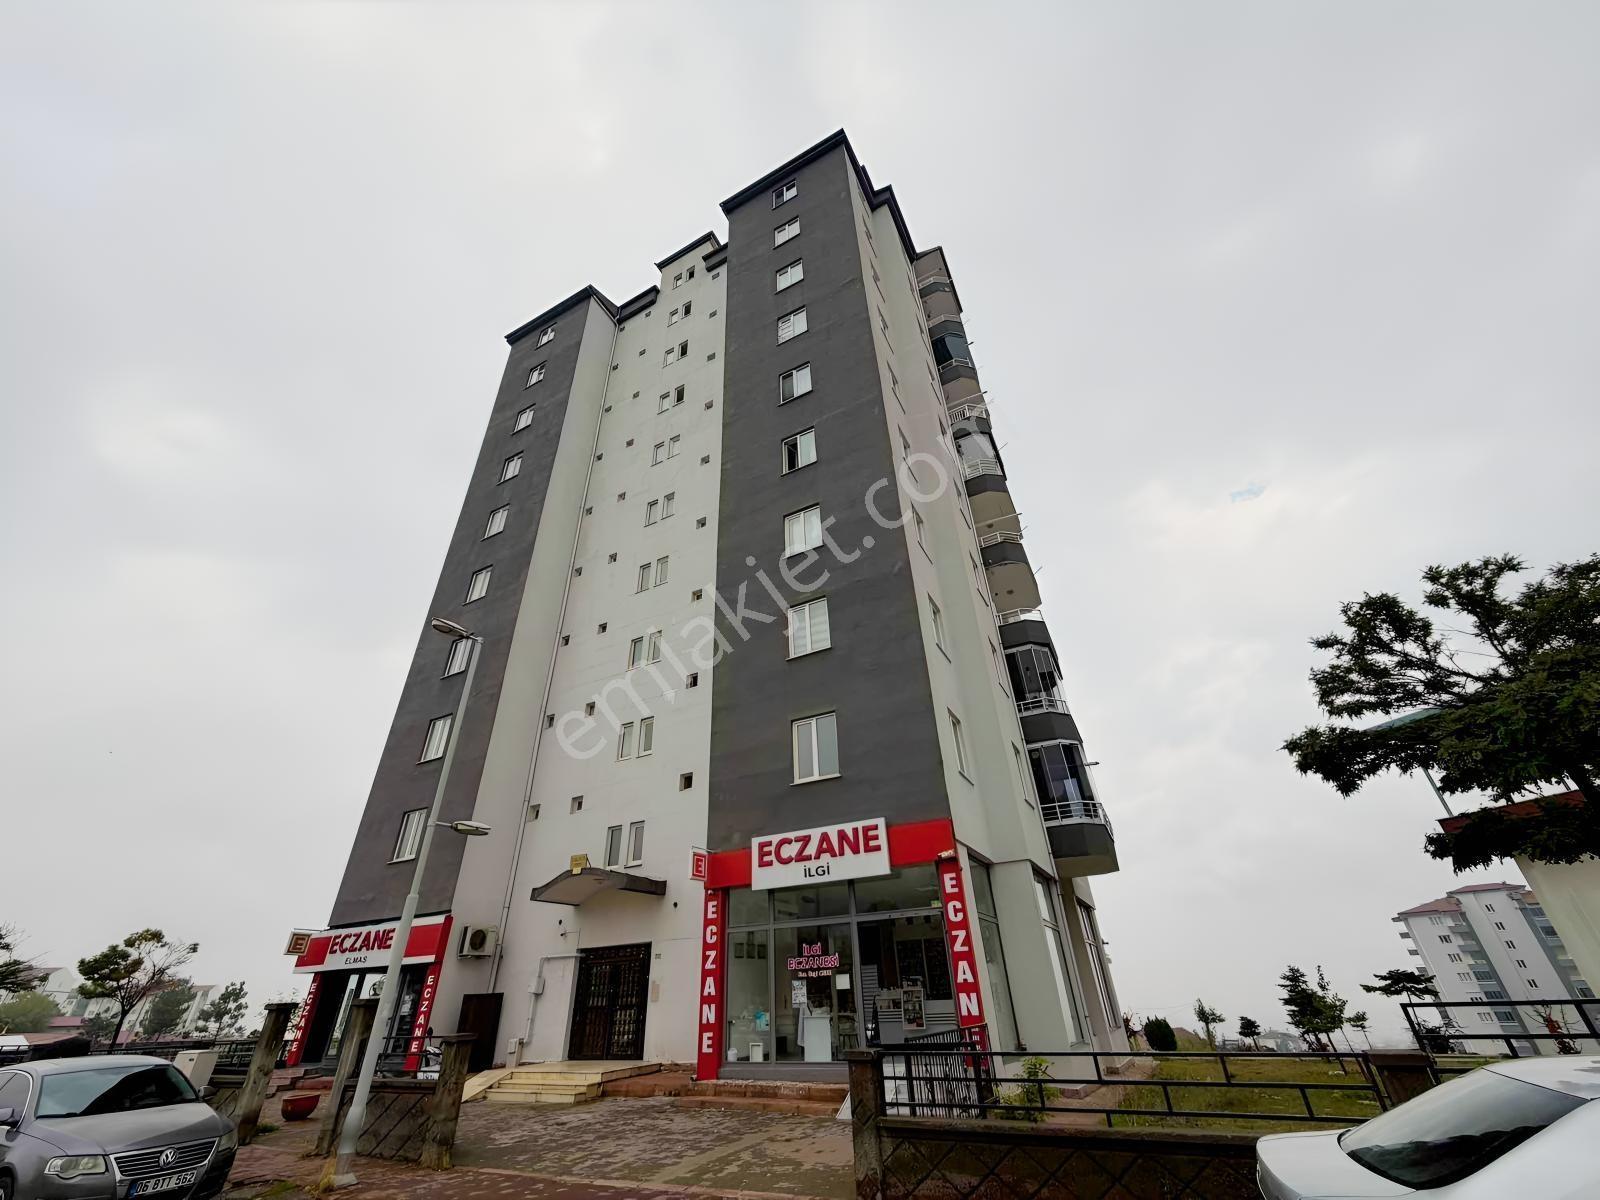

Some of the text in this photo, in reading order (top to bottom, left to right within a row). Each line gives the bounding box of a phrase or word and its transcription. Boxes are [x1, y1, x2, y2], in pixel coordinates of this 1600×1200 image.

[757, 823, 882, 867] ECZANE
[803, 864, 831, 879] İLGİ
[329, 928, 396, 954] ECZANE
[344, 956, 368, 965] ELMAS
[702, 900, 718, 1053] ECZANE
[291, 982, 318, 1051] ECZANE
[410, 975, 435, 1053] ECZANE
[137, 1172, 195, 1193] 06 BTT 562
